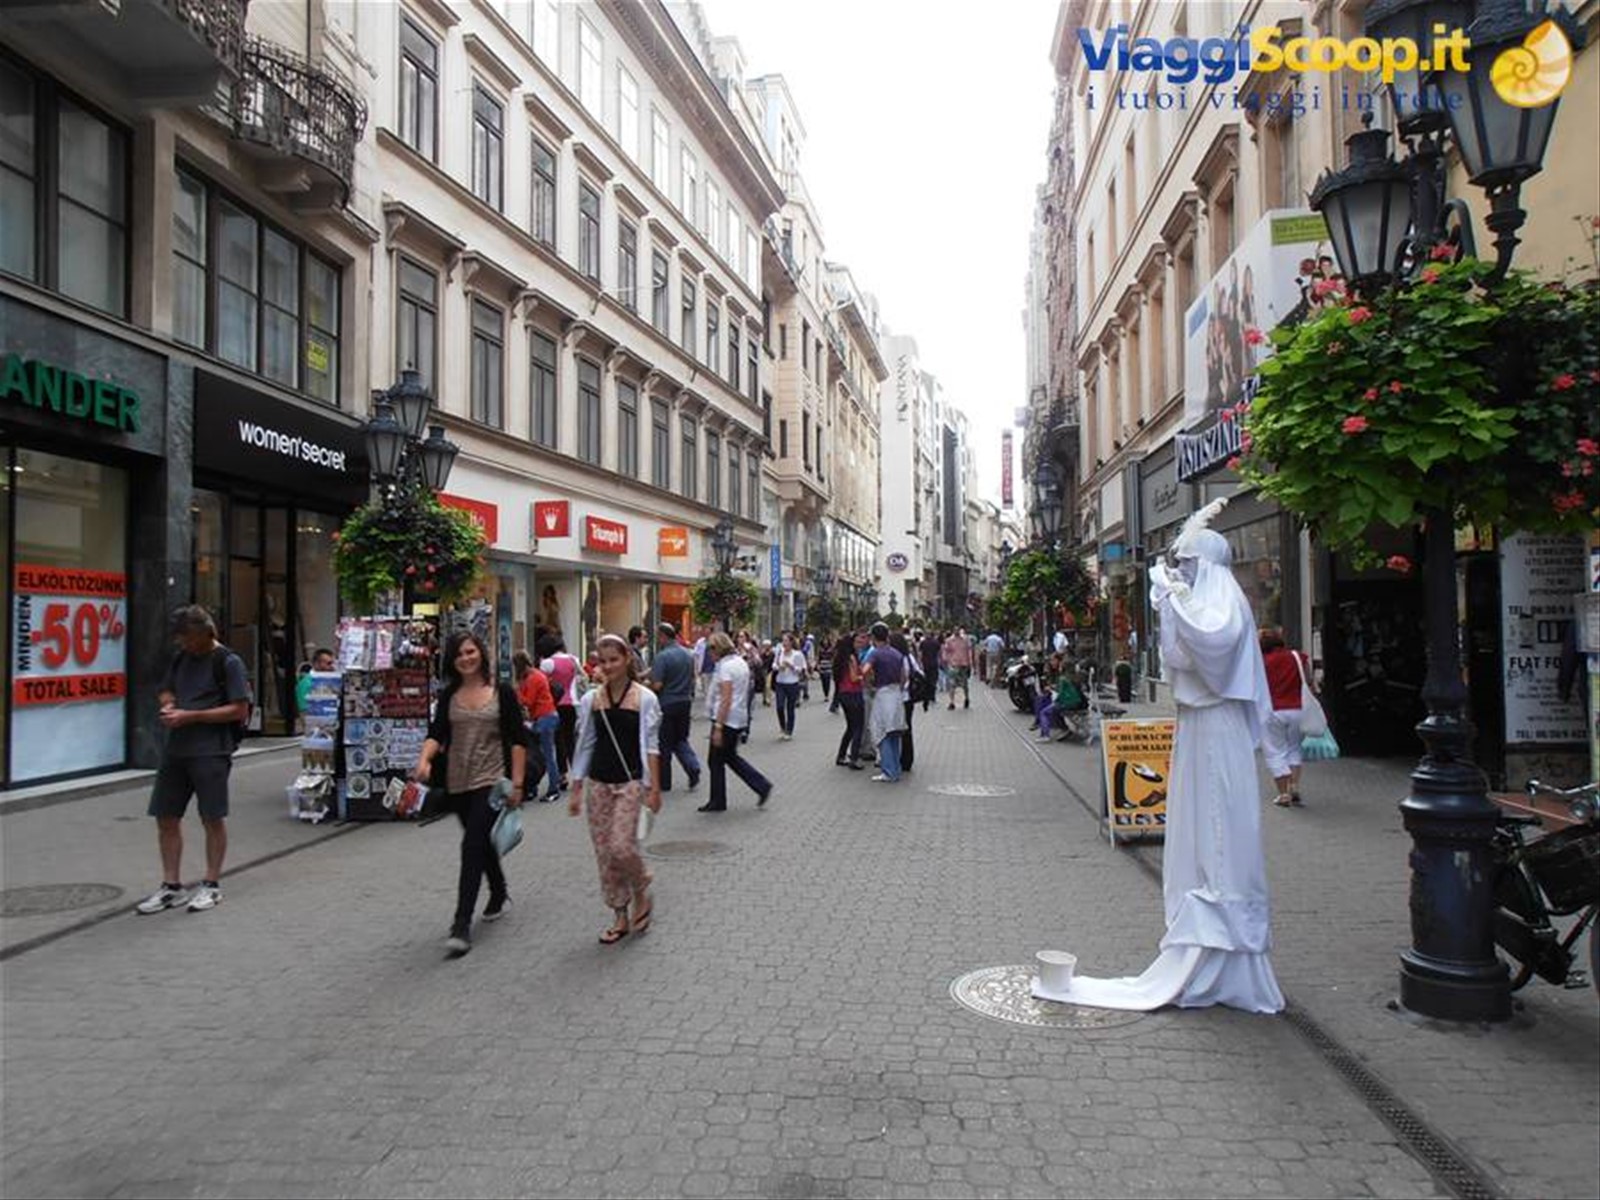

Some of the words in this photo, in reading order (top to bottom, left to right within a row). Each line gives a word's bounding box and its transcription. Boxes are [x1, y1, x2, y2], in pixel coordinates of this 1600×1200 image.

[17, 595, 31, 672] MINDEN
[1510, 656, 1541, 669] FLAT
[1545, 656, 1563, 669] FO
[24, 680, 75, 700] TOTAL
[79, 676, 118, 696] SALE
